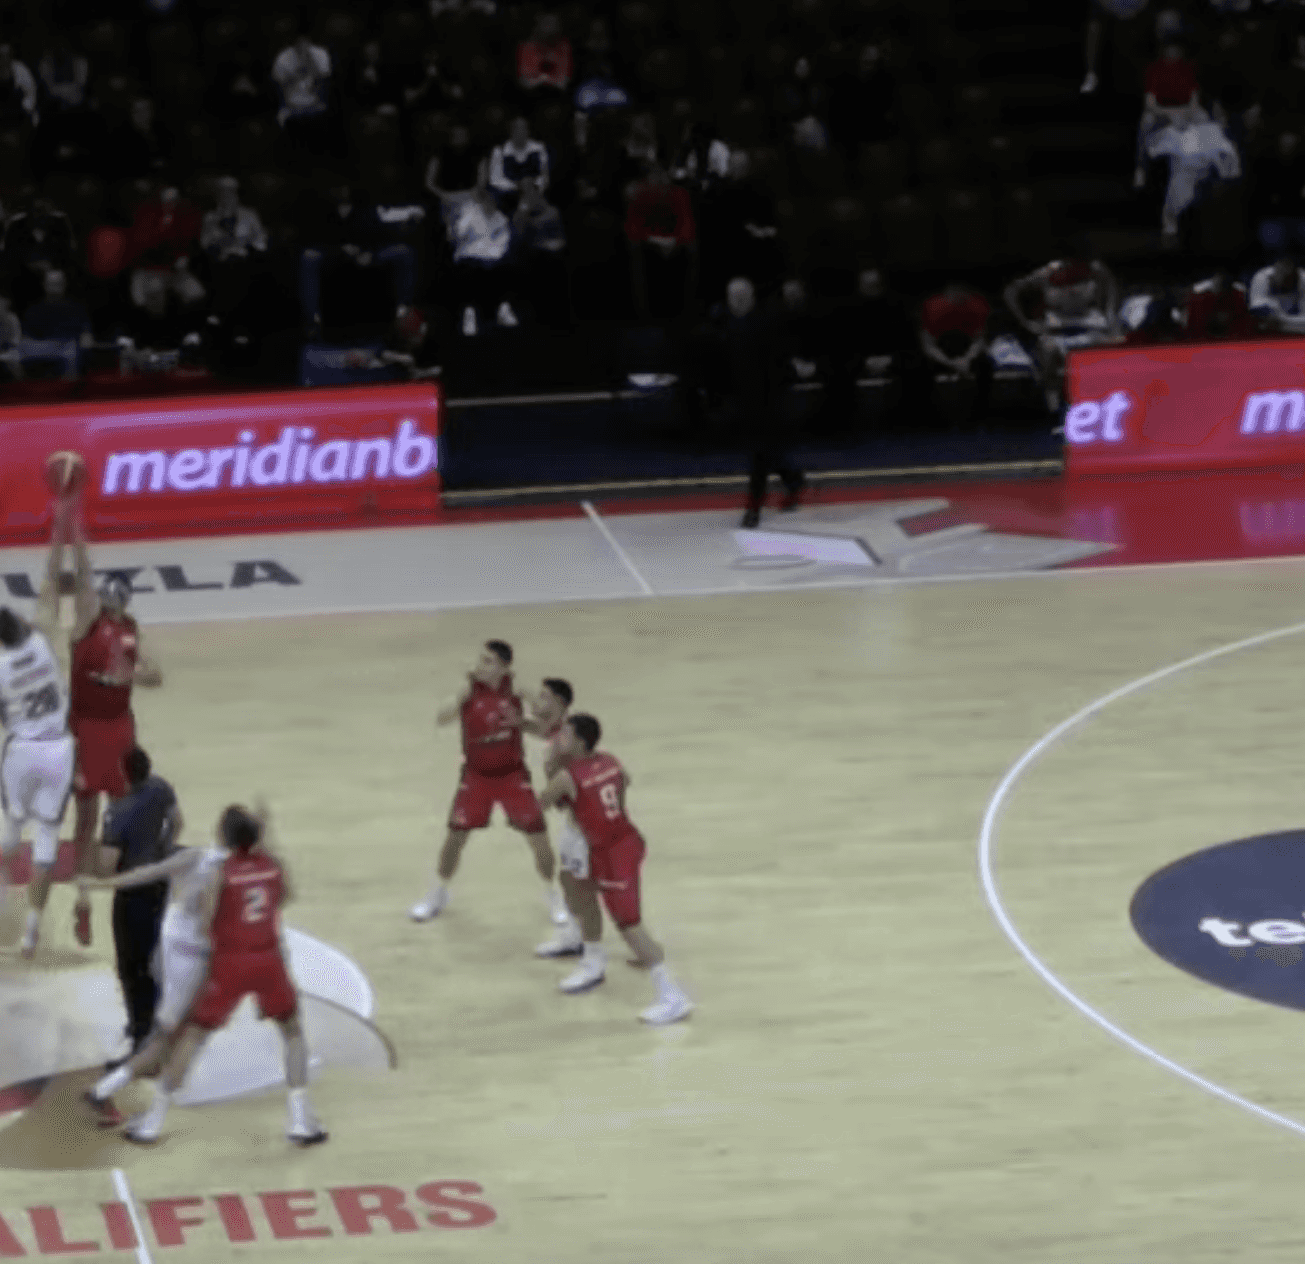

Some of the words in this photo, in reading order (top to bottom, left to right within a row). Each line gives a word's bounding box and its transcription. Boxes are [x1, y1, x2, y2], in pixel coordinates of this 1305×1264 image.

[1064, 391, 1131, 442] et
[102, 417, 437, 494] meridianb
[241, 886, 270, 923] 2
